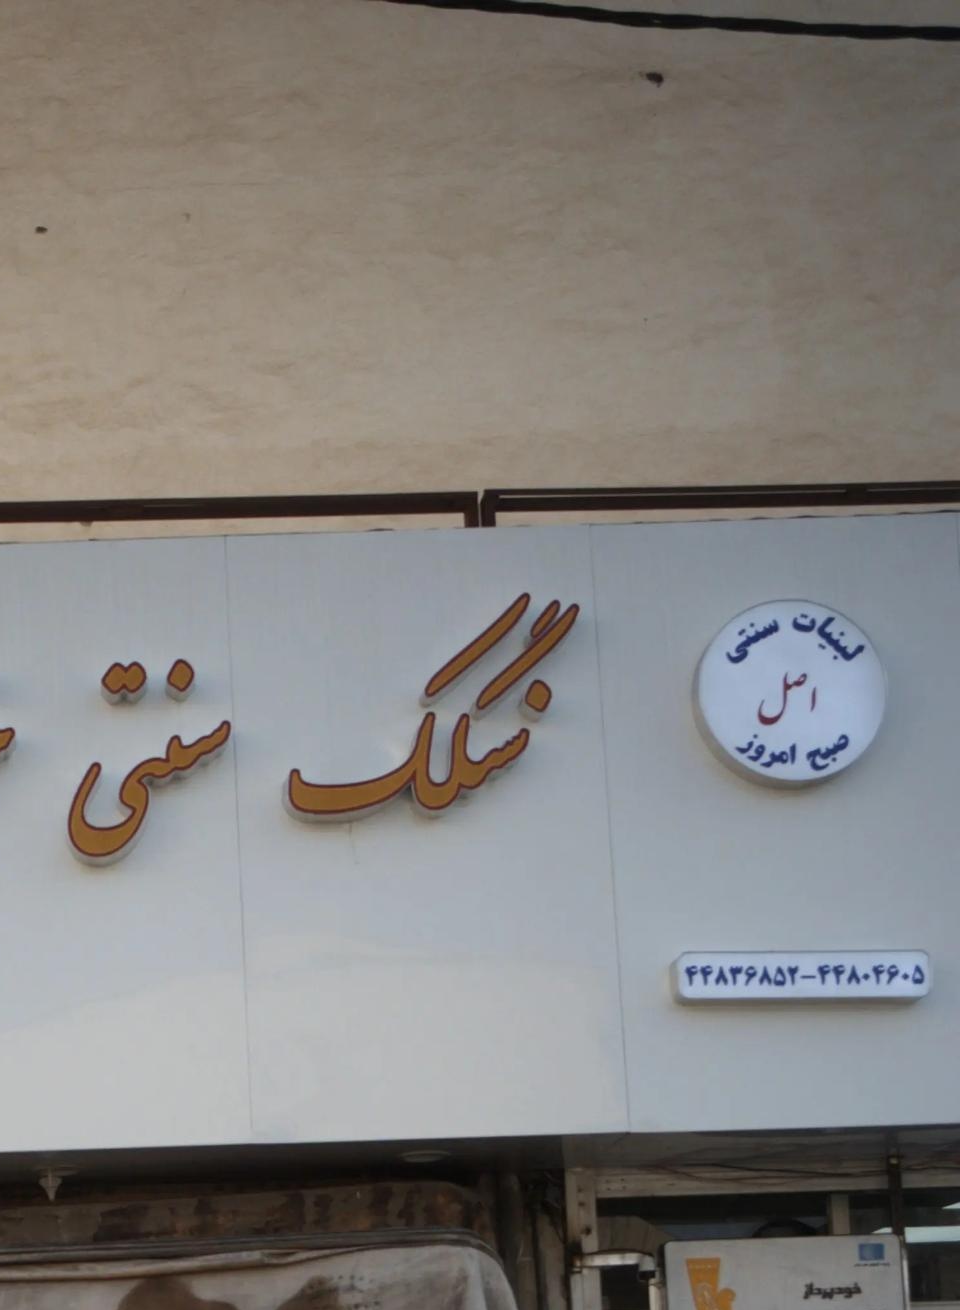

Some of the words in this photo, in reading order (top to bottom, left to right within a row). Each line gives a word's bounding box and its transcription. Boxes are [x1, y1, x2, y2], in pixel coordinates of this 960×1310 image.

[726, 619, 780, 664] سنتی
[792, 614, 865, 662] لبنیات
[289, 595, 579, 815] سنگک
[757, 671, 817, 726] اصل
[68, 660, 231, 858] سنتی
[735, 734, 798, 768] امروز
[806, 734, 850, 772] صبح
[803, 1282, 862, 1300] خودپرداز
